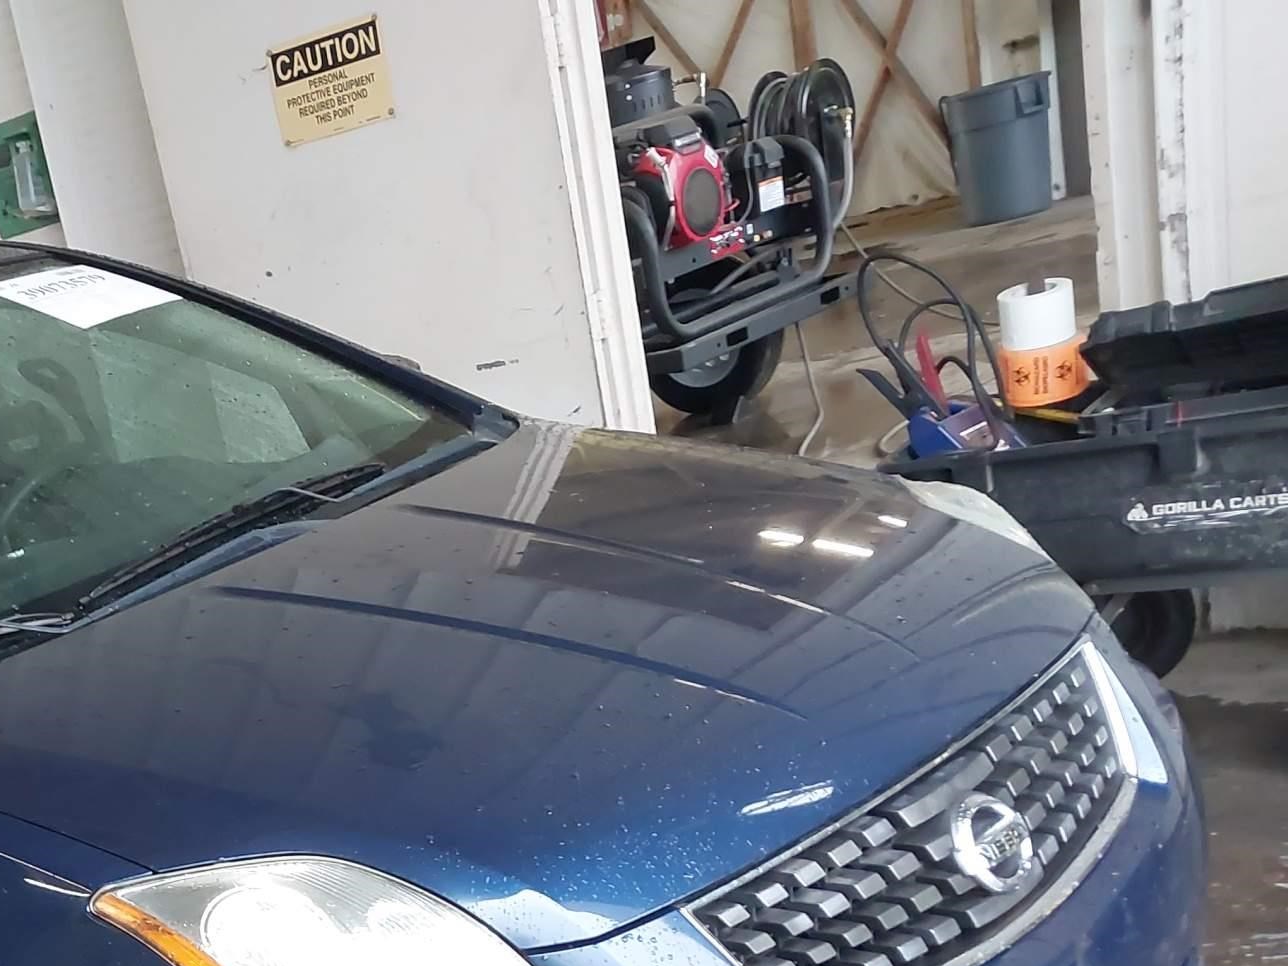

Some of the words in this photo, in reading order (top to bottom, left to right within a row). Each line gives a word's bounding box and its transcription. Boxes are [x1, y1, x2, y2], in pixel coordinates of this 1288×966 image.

[275, 26, 377, 82] CAUTION
[287, 87, 332, 109] PROTECTIVE
[333, 72, 376, 95] EQUIPMENT
[308, 69, 348, 89] PERSONAL
[298, 100, 336, 119] REQUIRED
[337, 88, 368, 106] BEYOND
[315, 112, 332, 125] THIS
[333, 104, 355, 120] POINT
[17, 274, 106, 300] 39073579
[1152, 497, 1225, 516] GORILLA
[1228, 493, 1288, 509] CARTS
